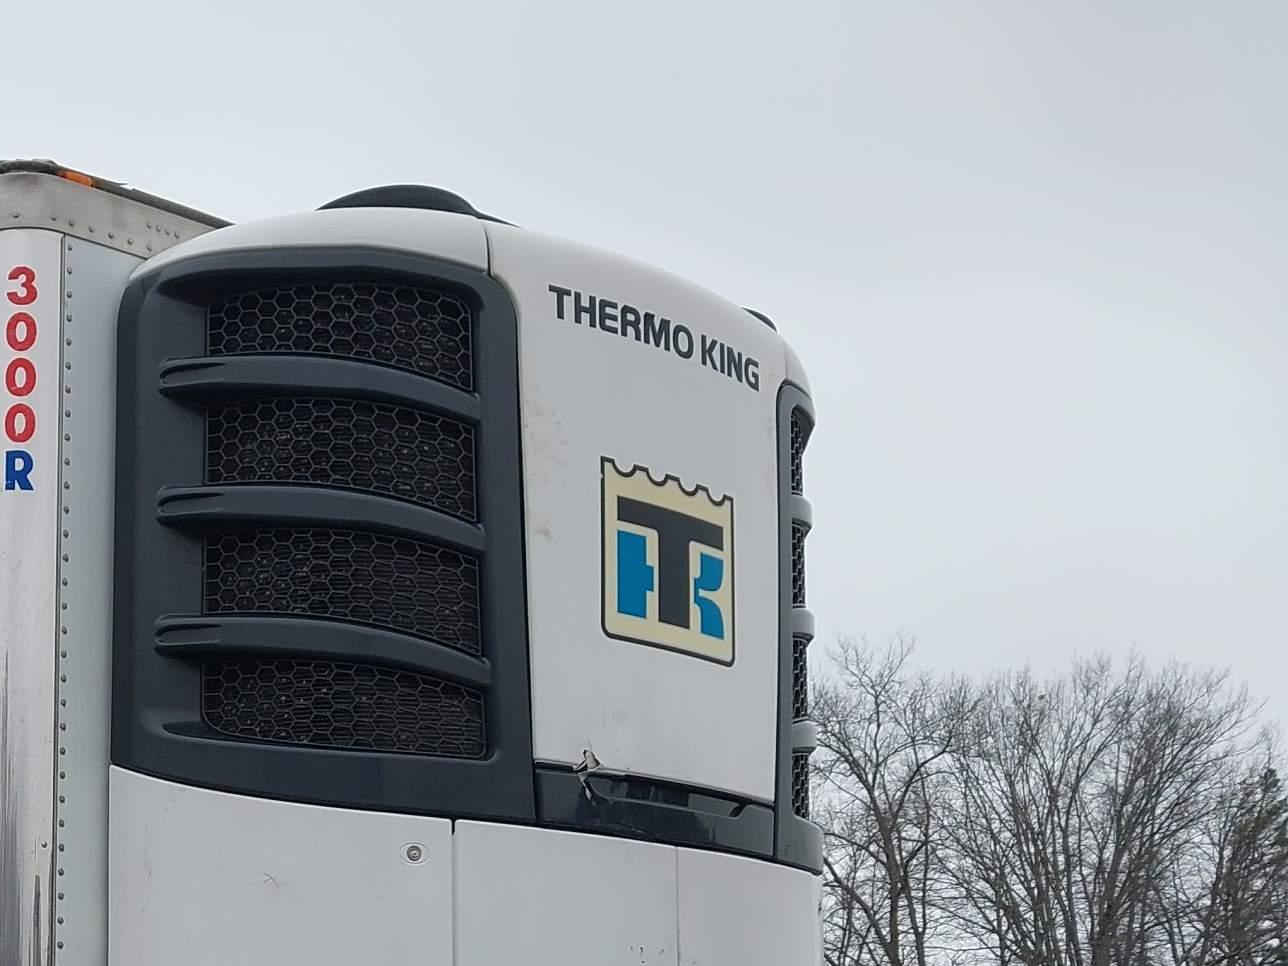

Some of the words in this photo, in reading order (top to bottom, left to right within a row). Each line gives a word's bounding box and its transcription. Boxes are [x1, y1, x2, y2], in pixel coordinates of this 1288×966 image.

[5, 266, 38, 491] 3000R
[548, 284, 695, 360] THERMO
[701, 333, 761, 393] KING
